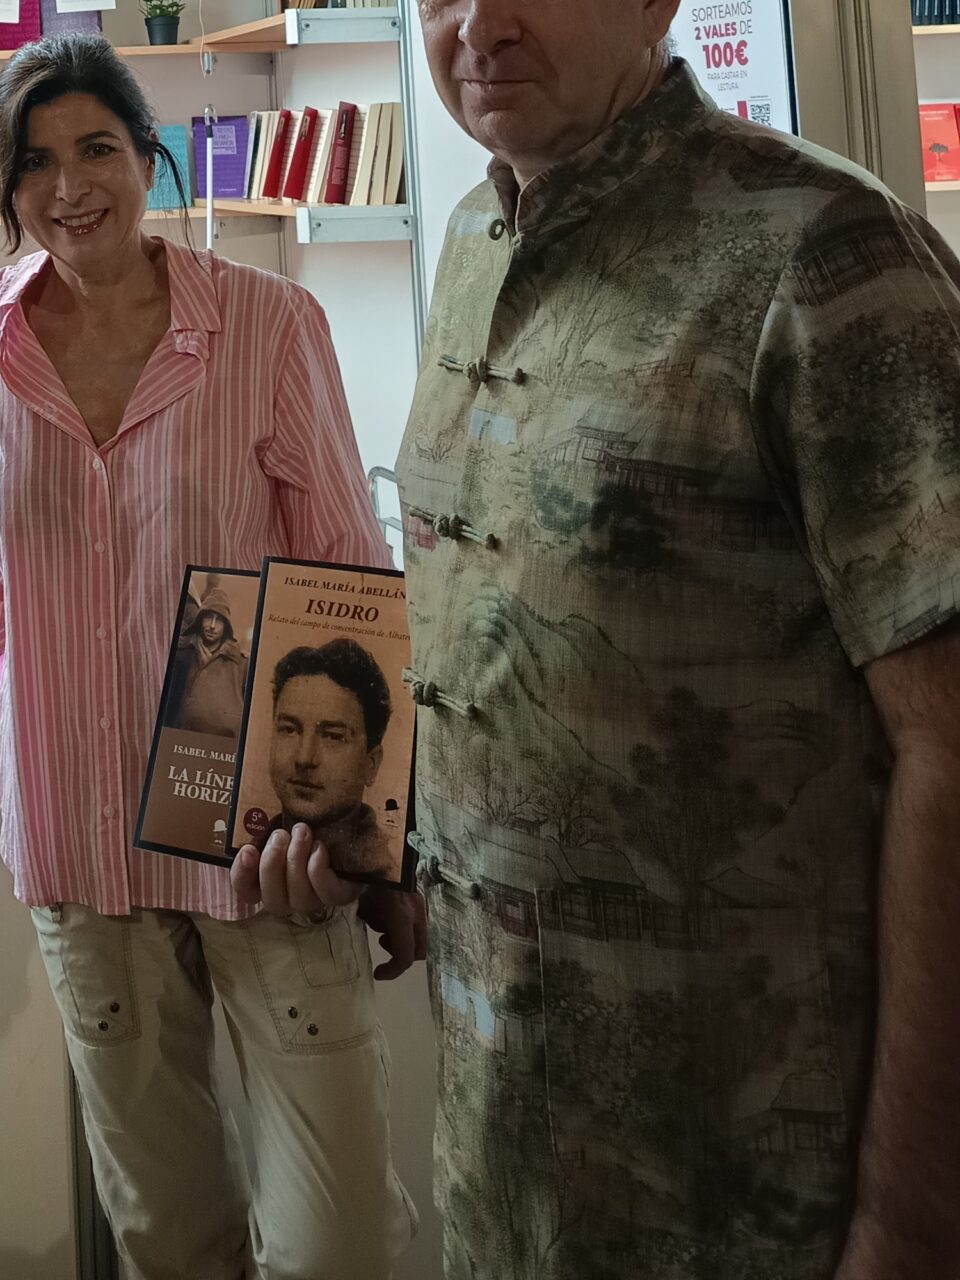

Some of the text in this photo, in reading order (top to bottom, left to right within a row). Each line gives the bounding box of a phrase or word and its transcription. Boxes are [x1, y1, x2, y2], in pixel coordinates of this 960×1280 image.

[692, 0, 753, 22] SORTEAMOS
[694, 20, 753, 40] 2 VALES DE
[702, 40, 749, 69] 100€
[284, 577, 407, 600] ISABEL MARÍA ABELLÁN
[305, 599, 379, 623] ISIDRO
[268, 613, 289, 624] Relato
[289, 617, 300, 625] del
[300, 620, 321, 630] campo
[322, 622, 330, 630] de
[330, 624, 376, 637] concentración
[173, 744, 207, 758] ISABEL
[167, 765, 189, 782] LA
[173, 782, 233, 806] HORIZ
[251, 811, 262, 822] 5ª
